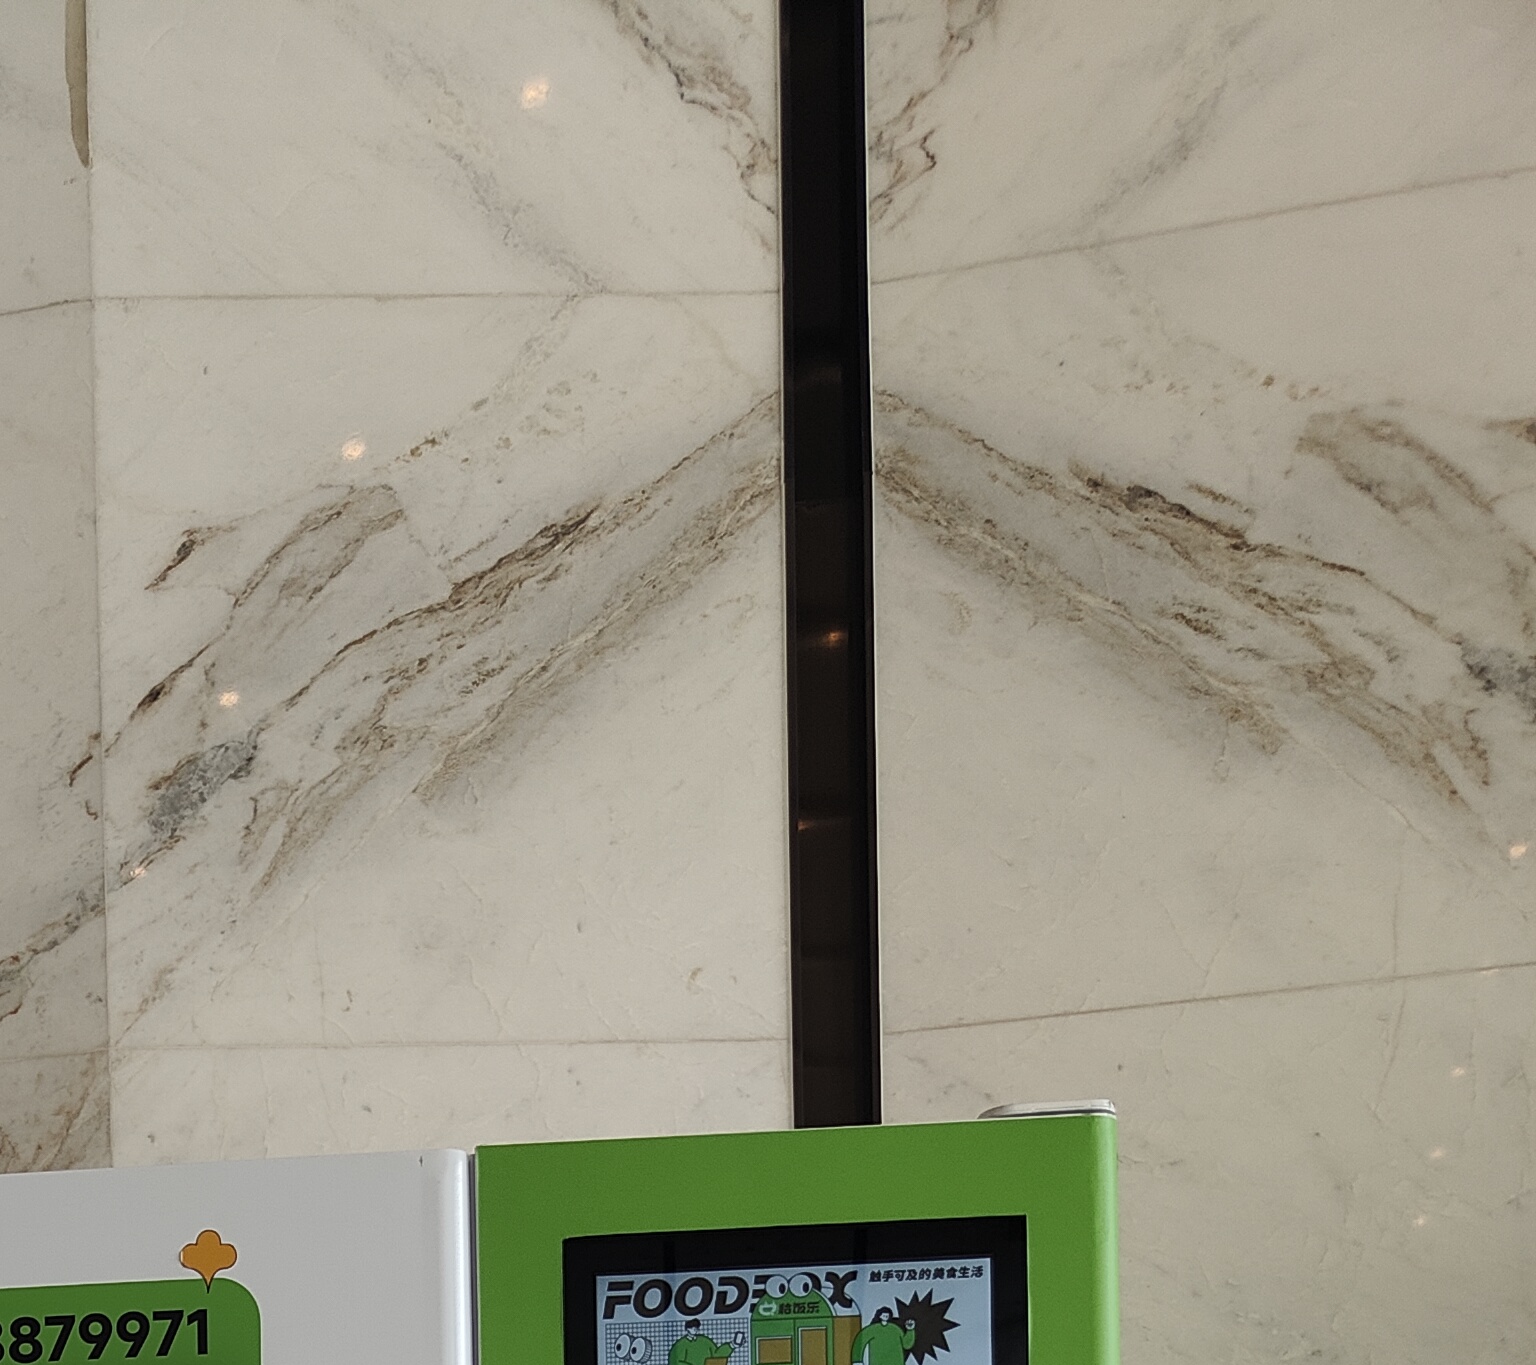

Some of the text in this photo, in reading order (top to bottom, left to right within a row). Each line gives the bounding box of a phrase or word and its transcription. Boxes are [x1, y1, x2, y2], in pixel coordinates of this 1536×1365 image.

[868, 1266, 984, 1282] 触手可及的美食生活
[603, 1270, 858, 1319] FOODX
